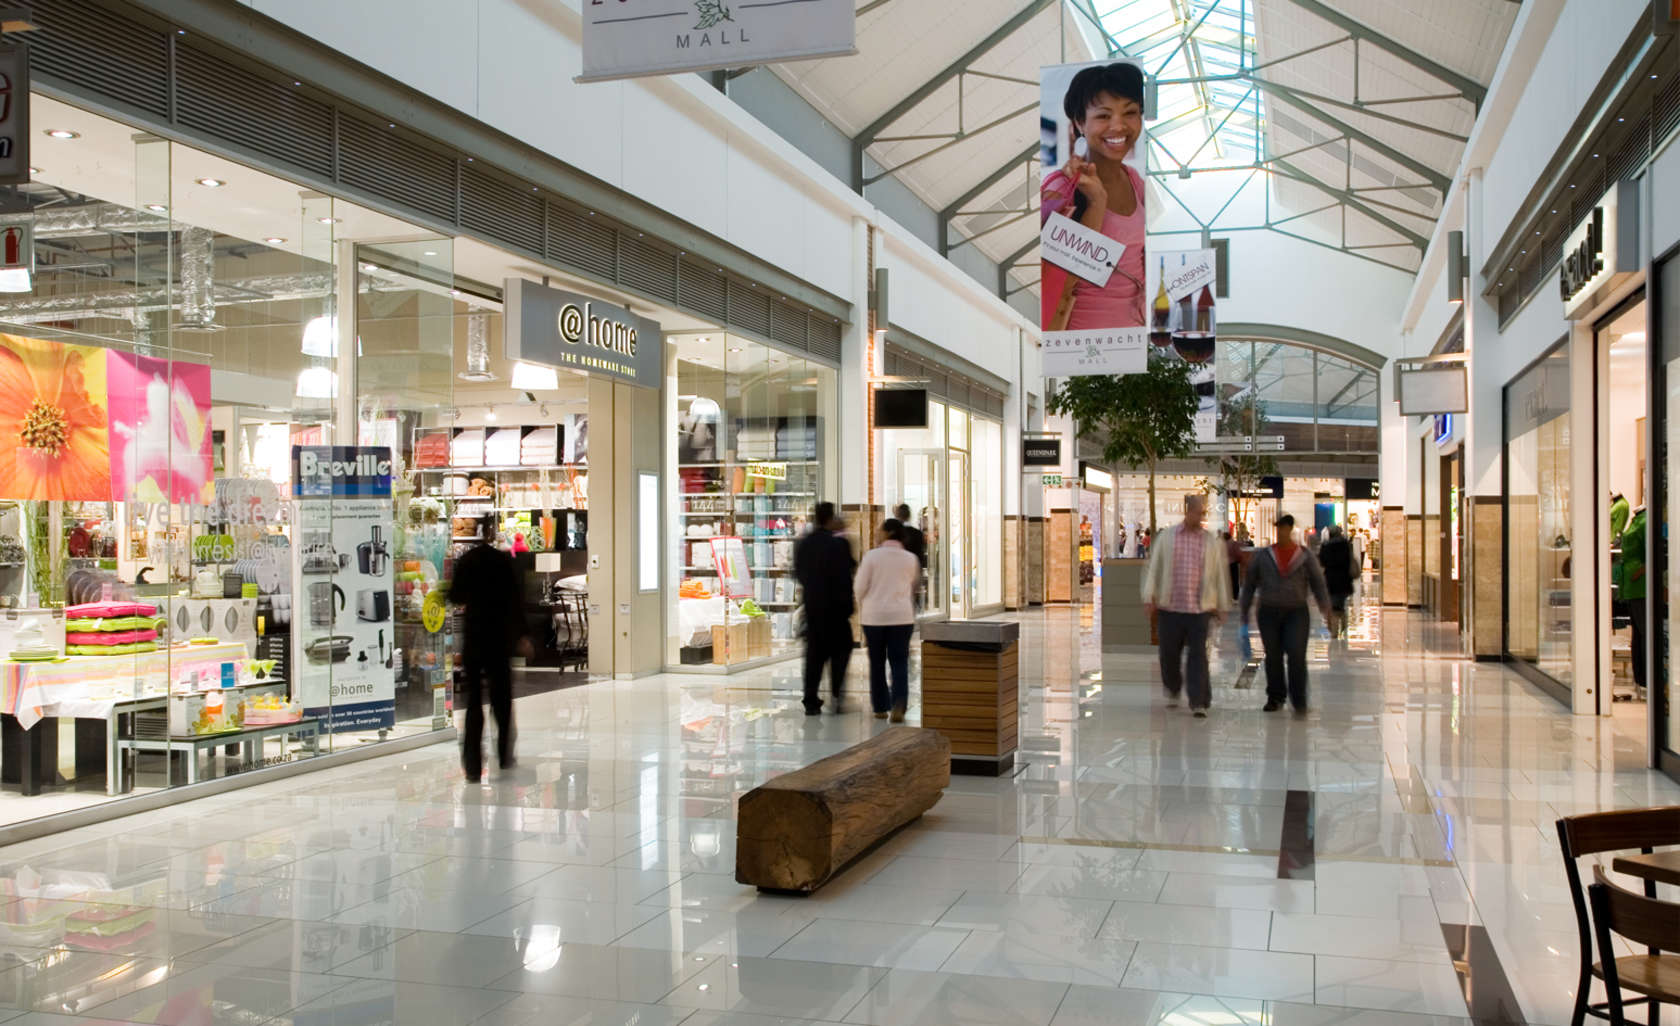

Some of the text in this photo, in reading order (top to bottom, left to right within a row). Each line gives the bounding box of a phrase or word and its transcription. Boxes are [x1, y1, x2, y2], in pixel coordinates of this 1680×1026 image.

[676, 28, 750, 49] MALL
[1050, 225, 1109, 263] UNWIND
[558, 301, 638, 358] @home
[1045, 333, 1142, 347] zevenwacht
[560, 352, 577, 364] THE
[581, 355, 619, 372] HOMEWARE
[299, 450, 391, 477] Breville
[329, 683, 374, 697] @home
